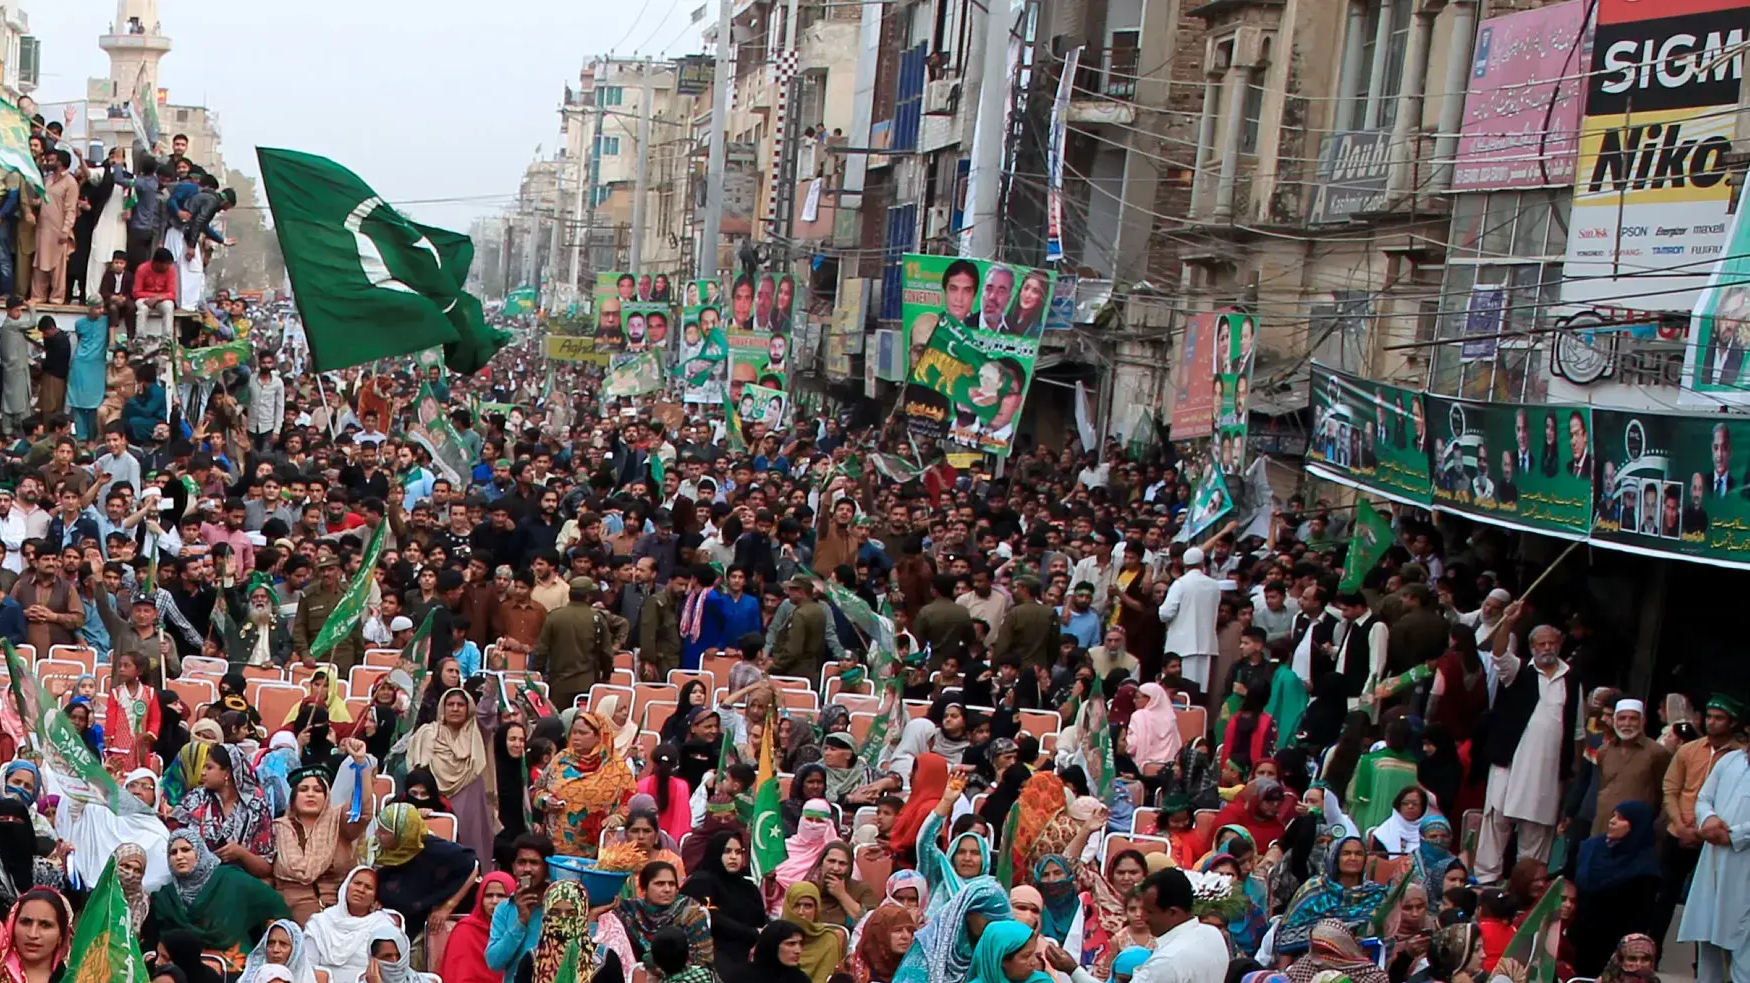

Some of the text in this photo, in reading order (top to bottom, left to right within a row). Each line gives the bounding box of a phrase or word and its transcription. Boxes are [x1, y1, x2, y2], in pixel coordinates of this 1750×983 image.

[1601, 29, 1743, 94] SIGM
[1588, 124, 1734, 192] Niko
[1578, 223, 1725, 239] SanDisk PSON Energizer maxell
[1608, 249, 1641, 257] SYANG
[1652, 246, 1685, 255] TAMRON
[904, 288, 942, 307] CONVENTION
